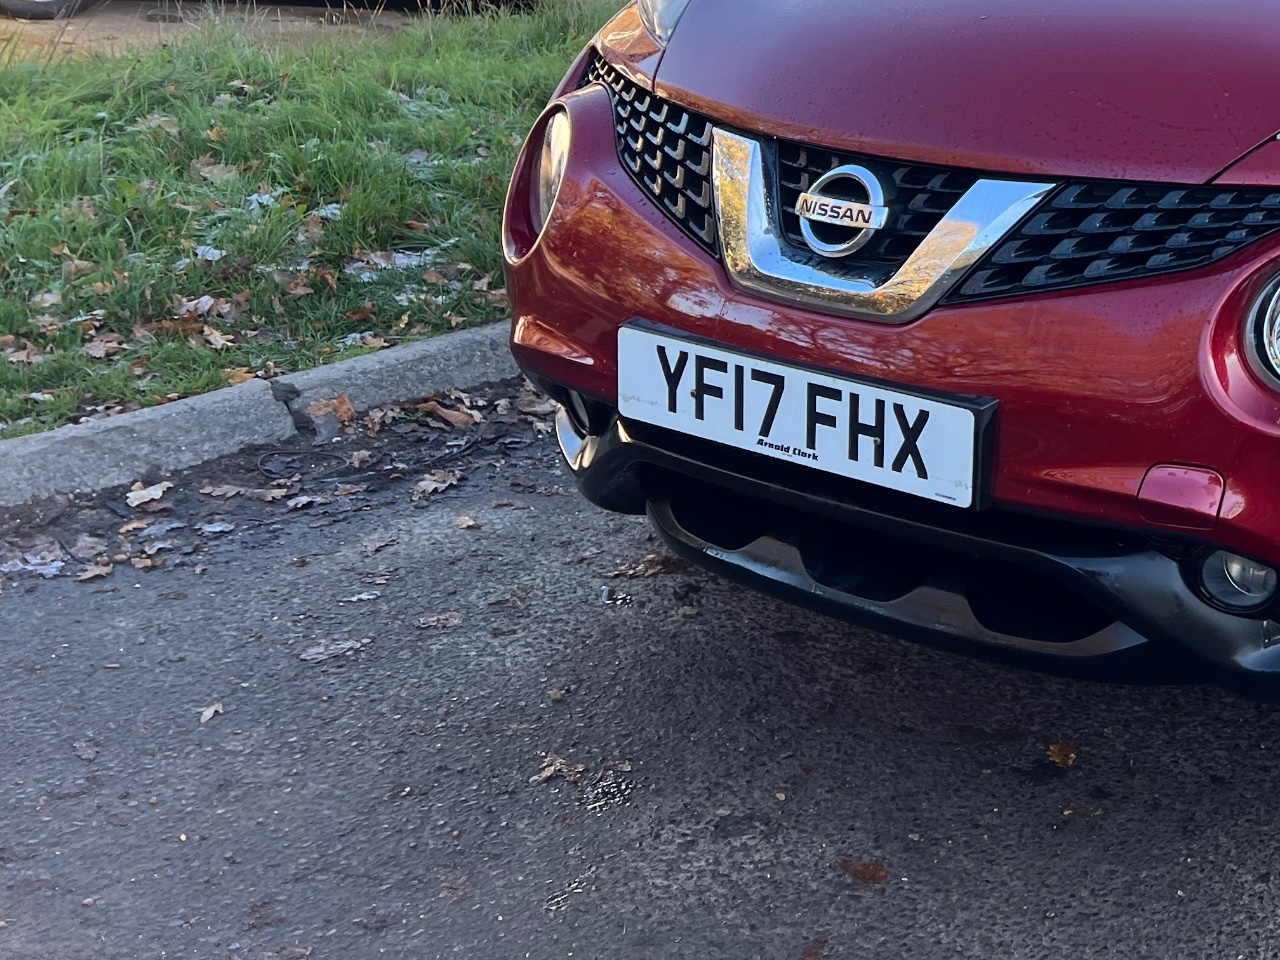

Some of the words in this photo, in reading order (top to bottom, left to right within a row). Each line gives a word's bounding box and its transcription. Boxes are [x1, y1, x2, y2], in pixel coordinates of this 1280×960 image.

[800, 198, 873, 224] NISSAN
[656, 344, 785, 438] YF17
[805, 381, 930, 480] FHX
[756, 438, 791, 453] Arnold
[792, 447, 819, 461] Clark
